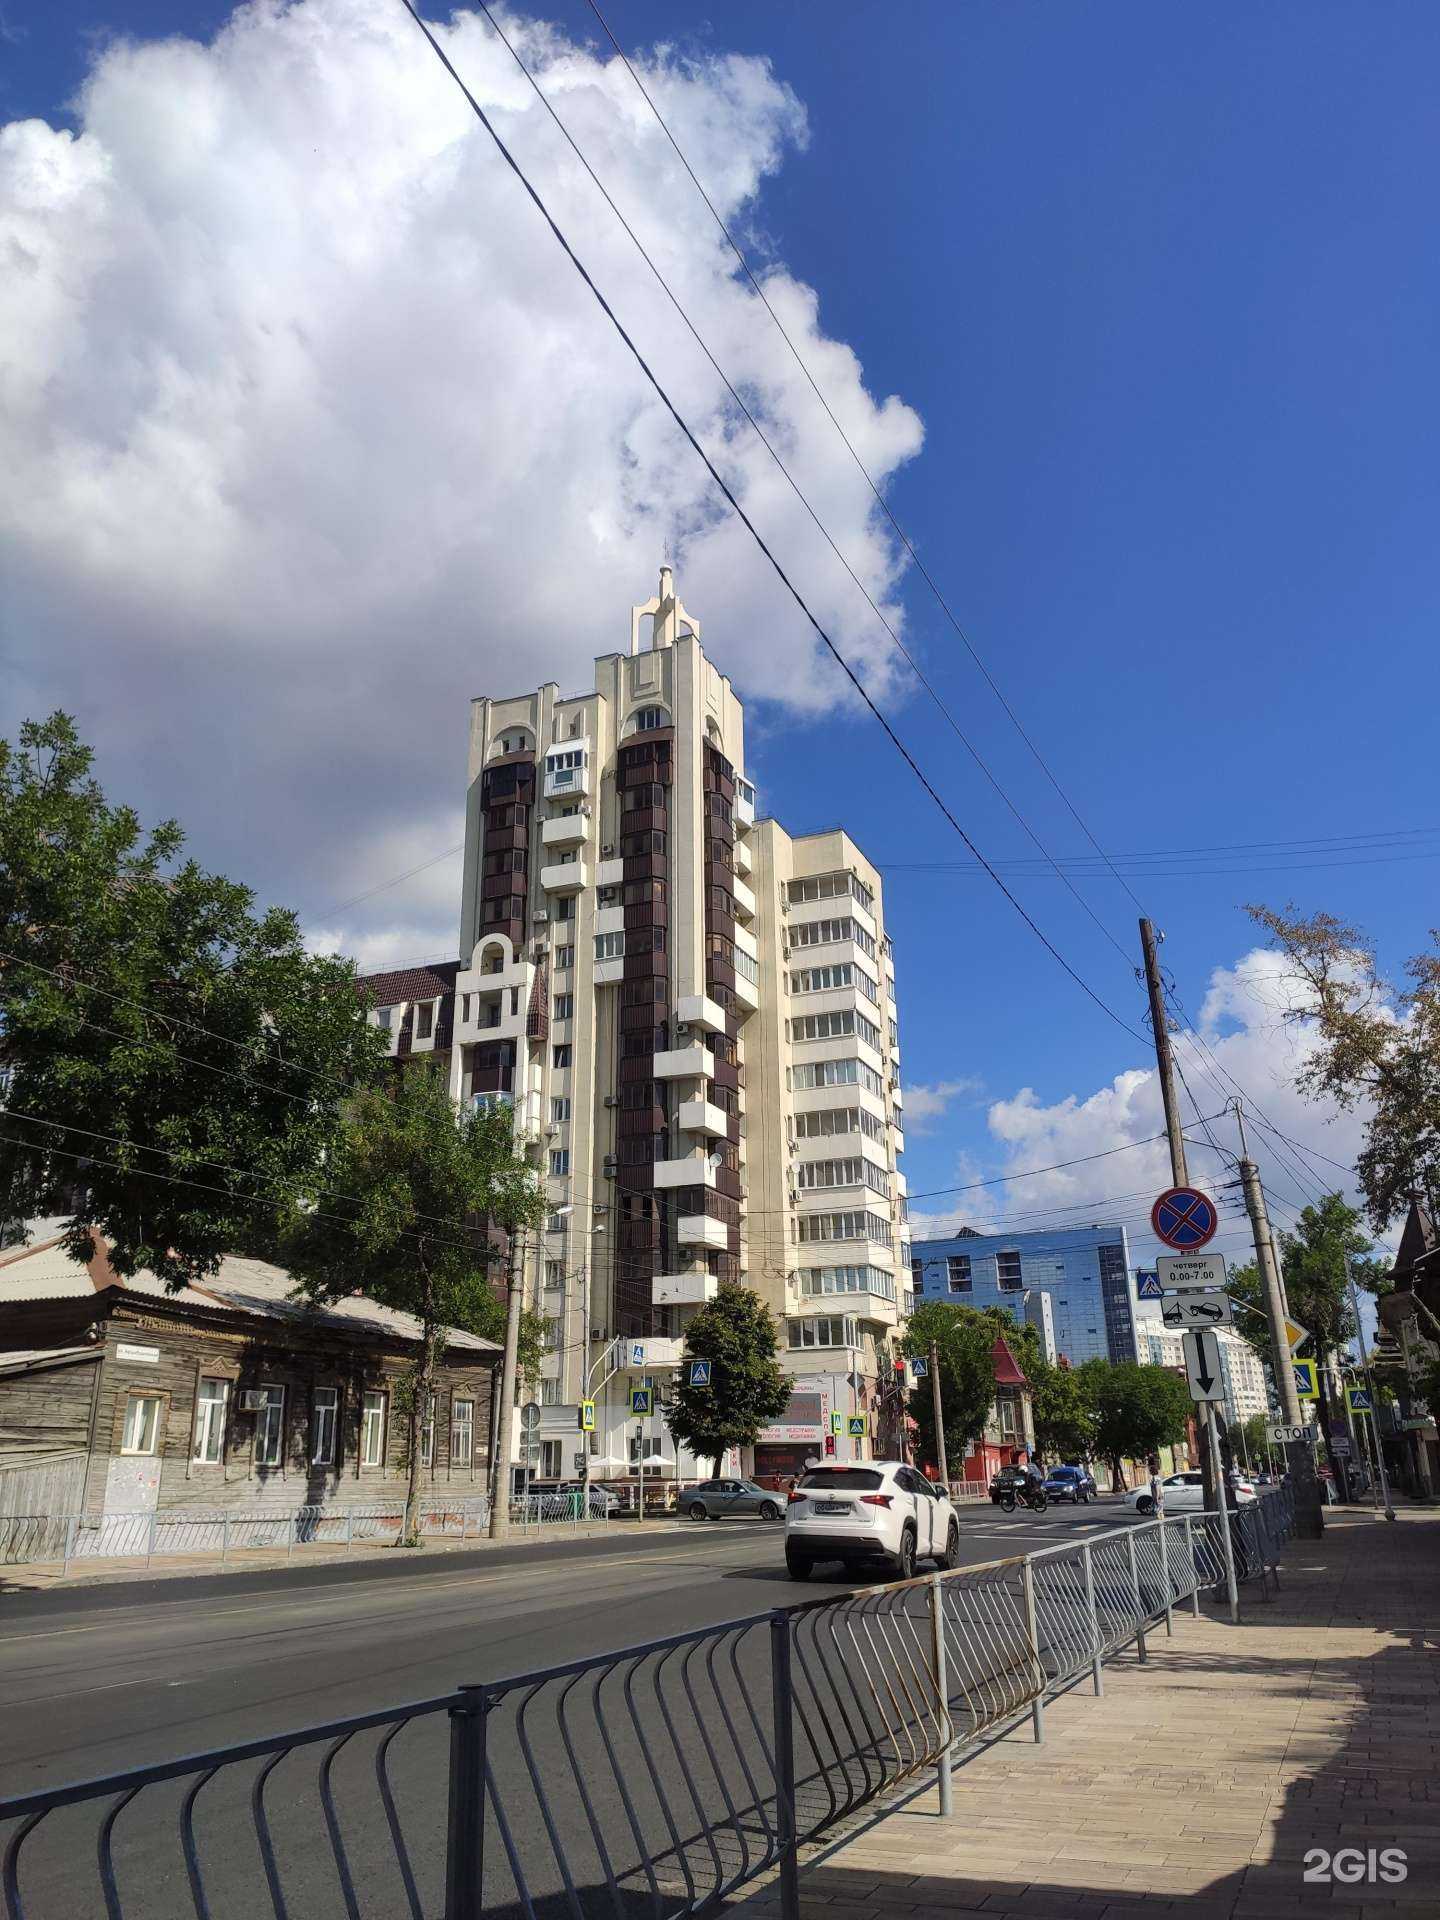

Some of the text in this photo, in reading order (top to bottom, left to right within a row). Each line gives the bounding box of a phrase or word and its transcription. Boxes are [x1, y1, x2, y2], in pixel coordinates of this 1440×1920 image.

[1173, 1261, 1208, 1270] четверг
[1169, 1270, 1215, 1281] 0.00-7.00
[1274, 1427, 1312, 1440] СТОП
